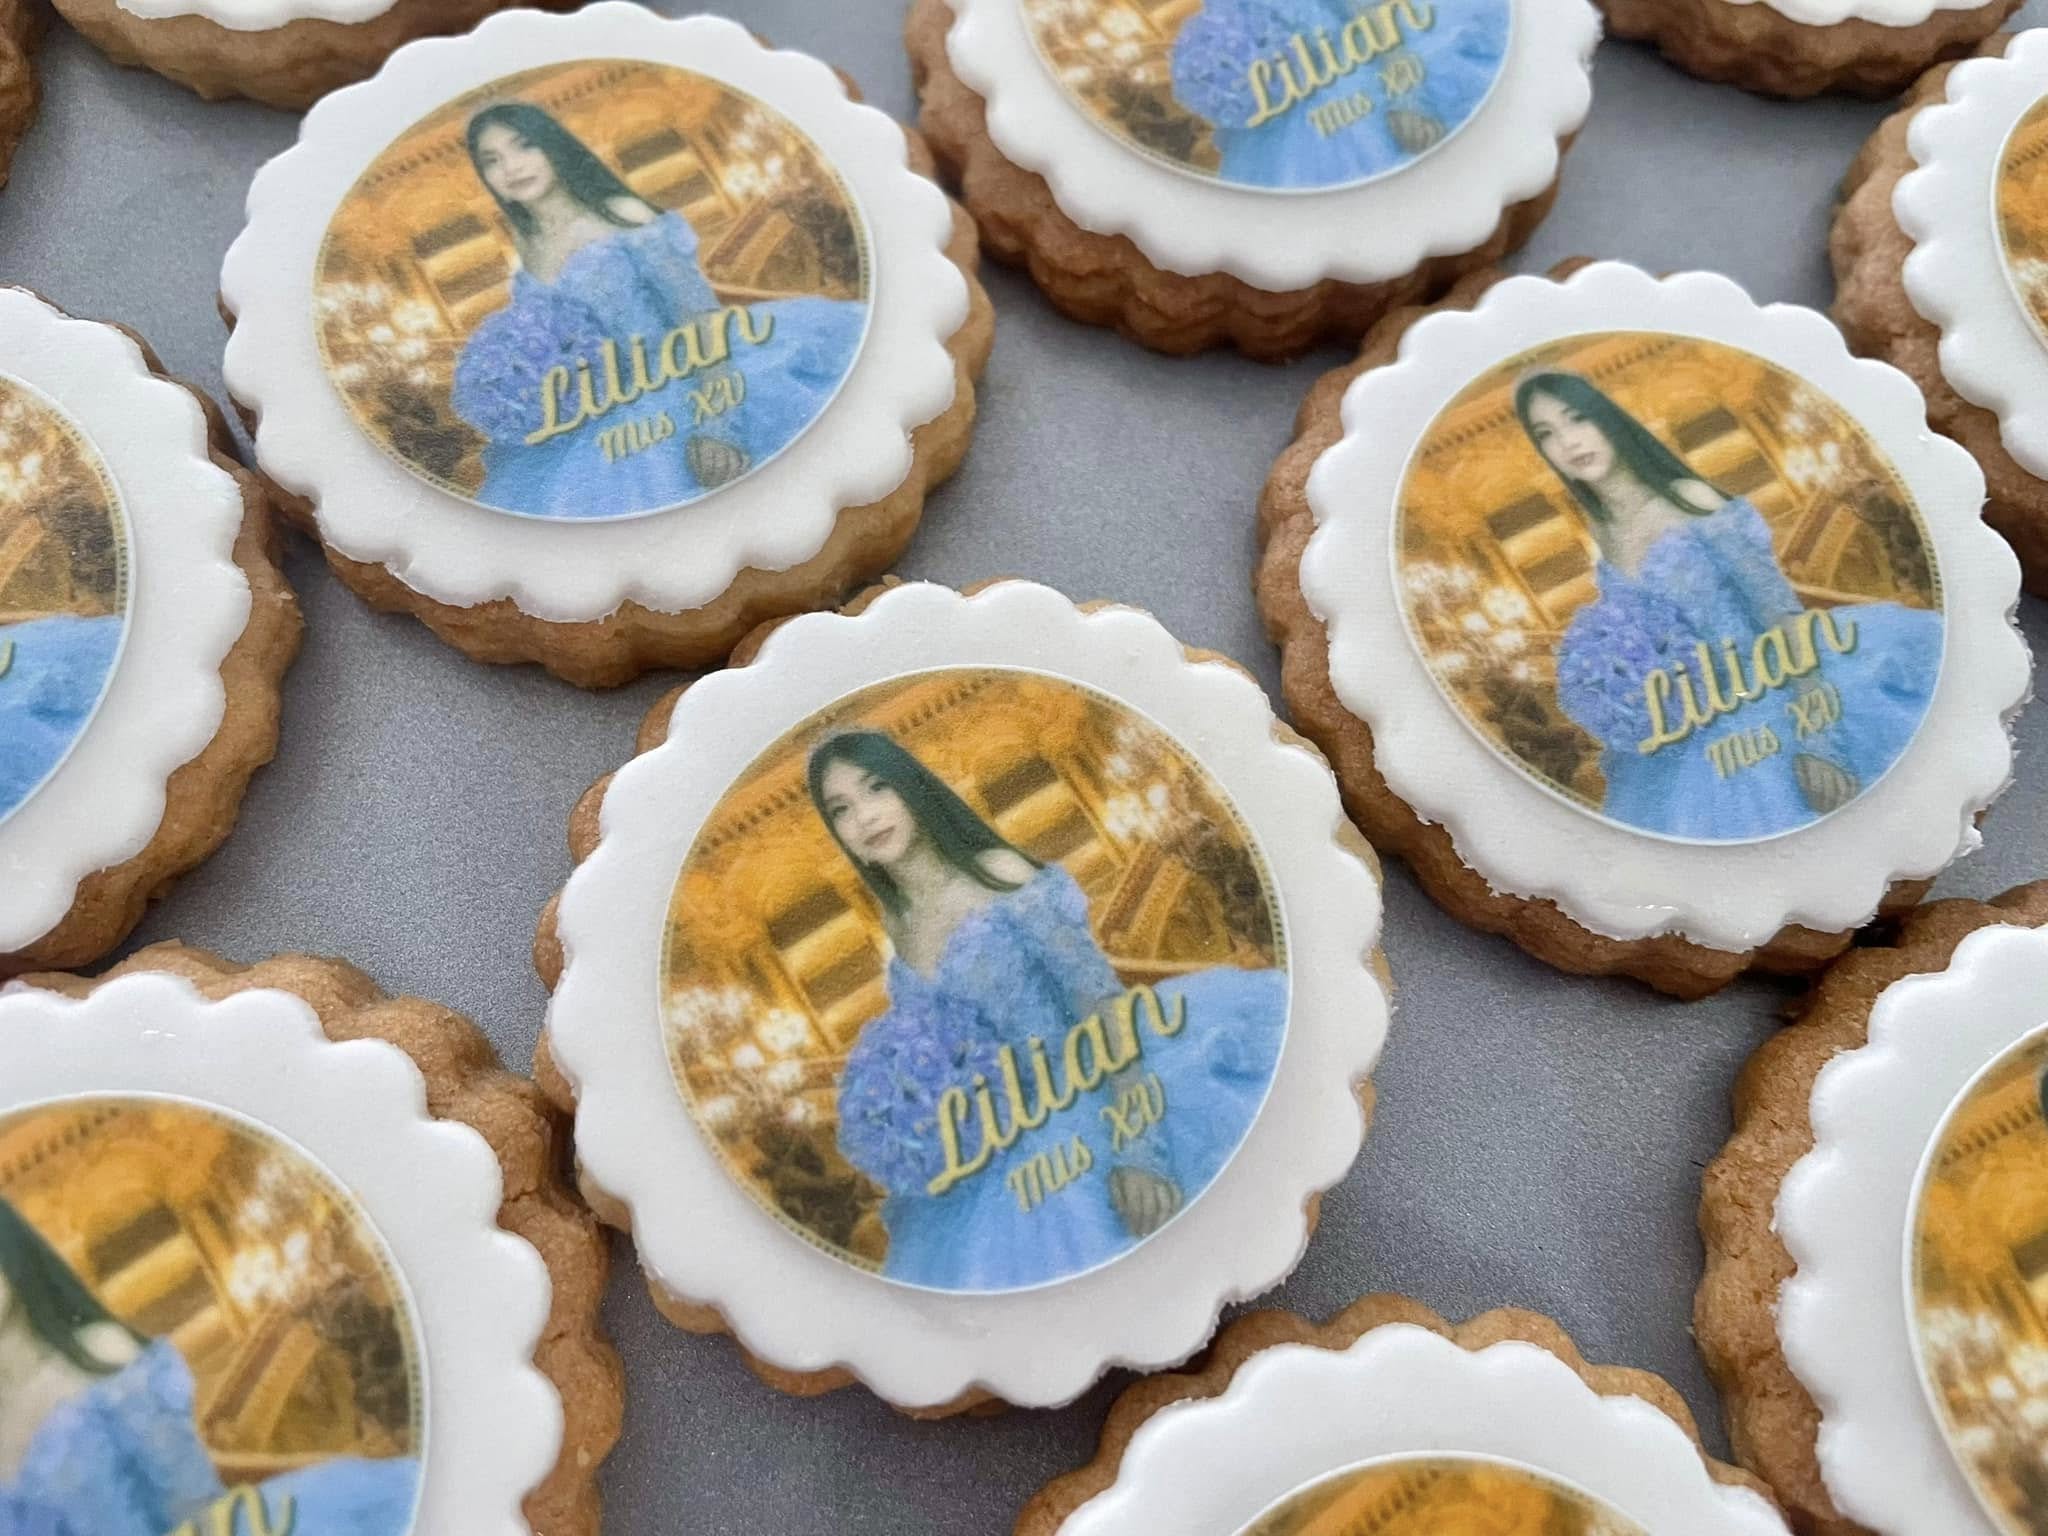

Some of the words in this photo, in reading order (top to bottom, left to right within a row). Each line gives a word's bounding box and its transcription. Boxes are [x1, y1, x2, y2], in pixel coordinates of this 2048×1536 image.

[1247, 0, 1434, 128] Lilian
[524, 304, 774, 445] Lilian
[1638, 608, 1857, 754] Lilian
[926, 983, 1185, 1195] Lilian
